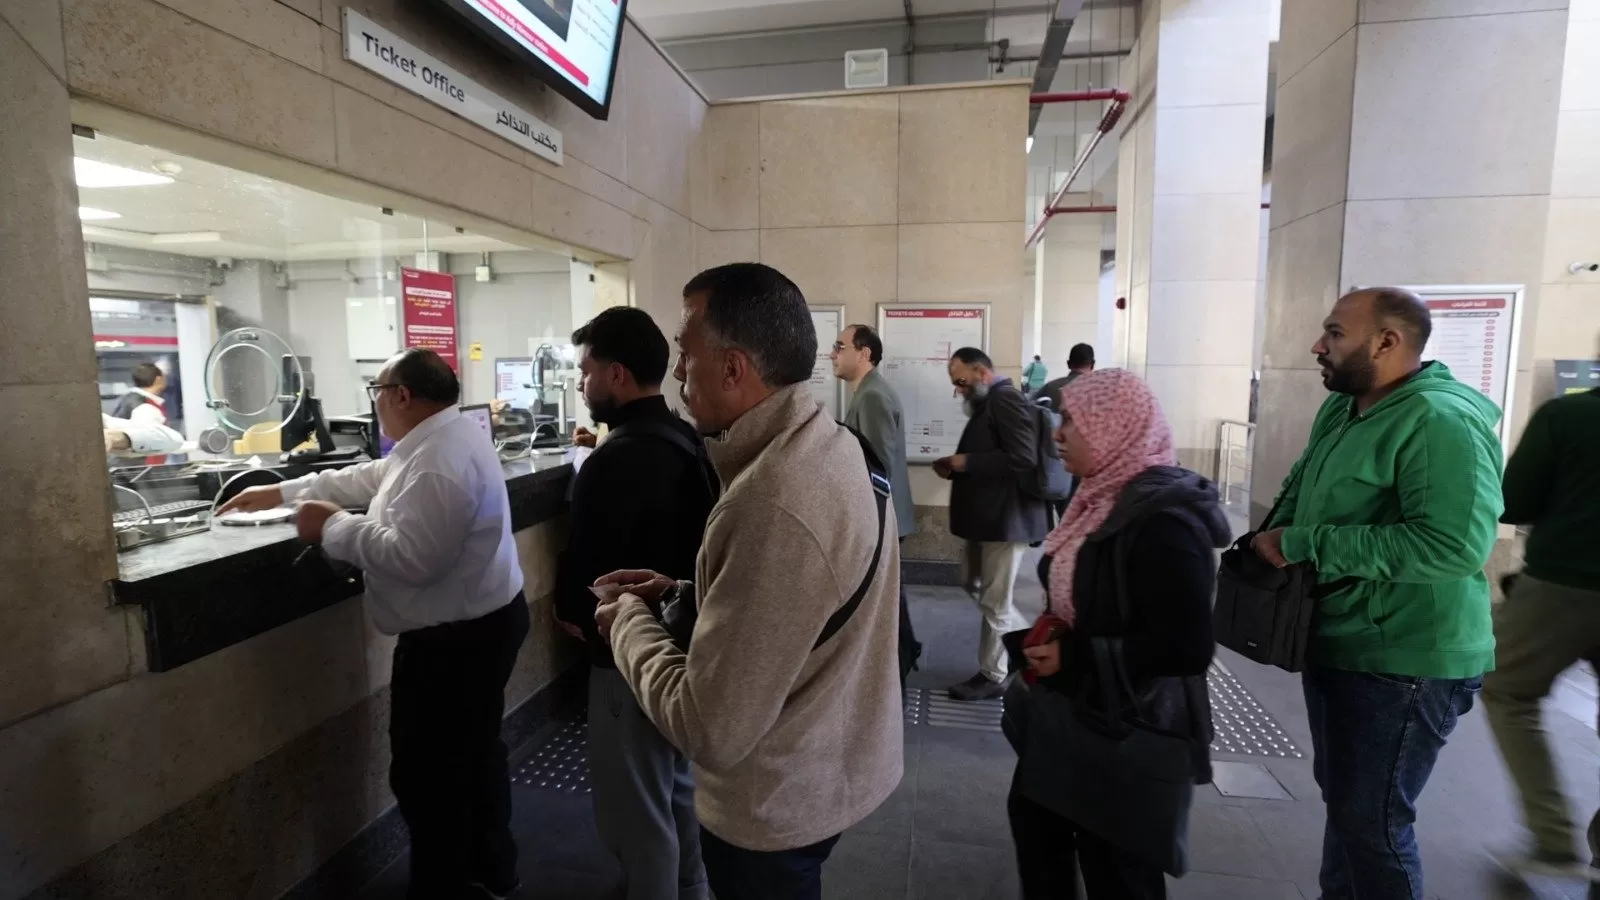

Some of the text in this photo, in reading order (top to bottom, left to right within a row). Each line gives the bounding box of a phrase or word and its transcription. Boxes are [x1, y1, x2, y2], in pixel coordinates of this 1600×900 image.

[362, 31, 465, 102] Ticket Office
[496, 110, 557, 153] مكتب التذاكر
